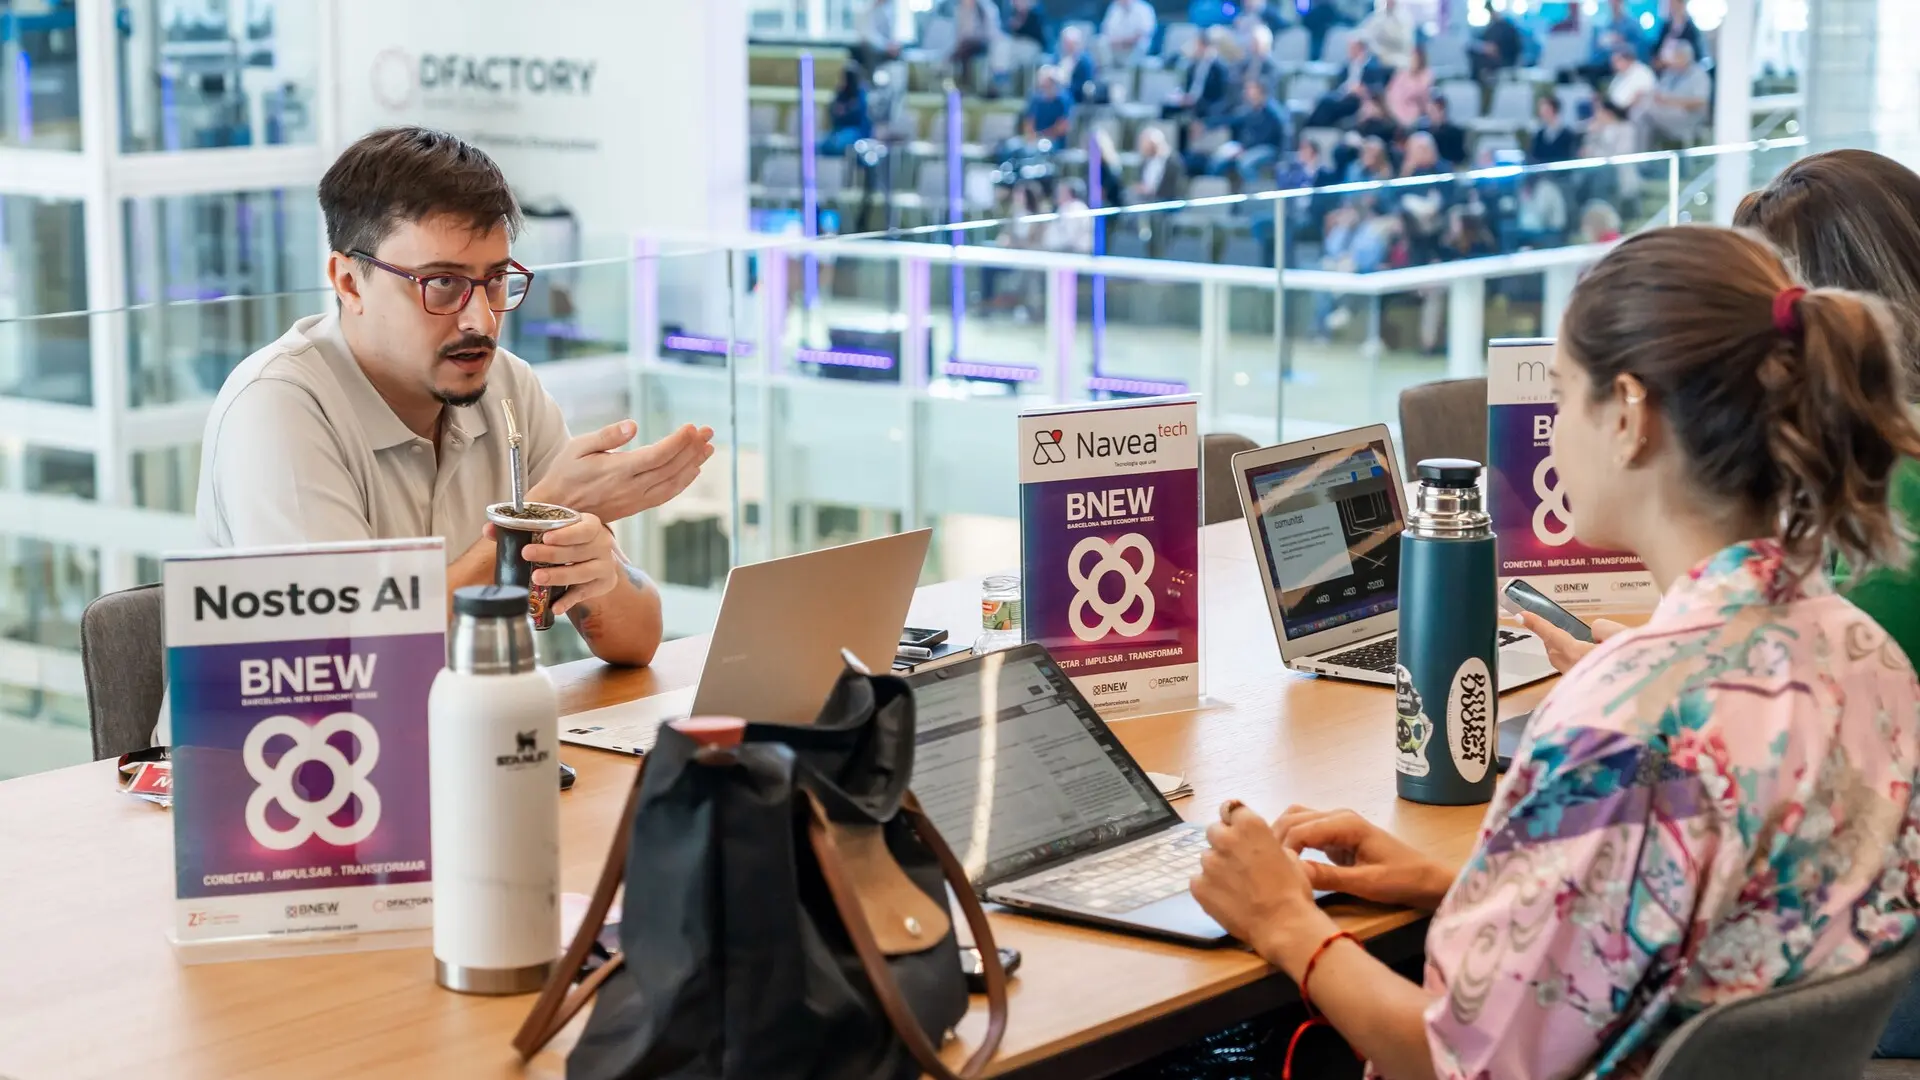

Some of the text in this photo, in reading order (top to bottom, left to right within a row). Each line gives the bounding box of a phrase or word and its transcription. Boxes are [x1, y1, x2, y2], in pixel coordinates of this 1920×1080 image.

[418, 53, 598, 93] DFACTORY
[1077, 421, 1188, 459] Navea tech
[1066, 486, 1155, 521] BNEW
[1067, 515, 1155, 530] BARCELONA NEW ECONOMY WEEK
[1503, 555, 1642, 569] CONECTAR IMPULSAR TRANSFORMA
[193, 575, 421, 622] Nostos AI
[1563, 583, 1589, 592] BNEW
[1057, 647, 1183, 669] ECTAR IMPULSAR TRANSFORMAR
[239, 653, 378, 697] BNEW
[1157, 675, 1189, 685] DFACTORY
[1101, 682, 1128, 693] BNEW
[203, 860, 426, 886] CONECTAR IMPULSAR TRANSFORMAR
[299, 901, 340, 915] BNEW
